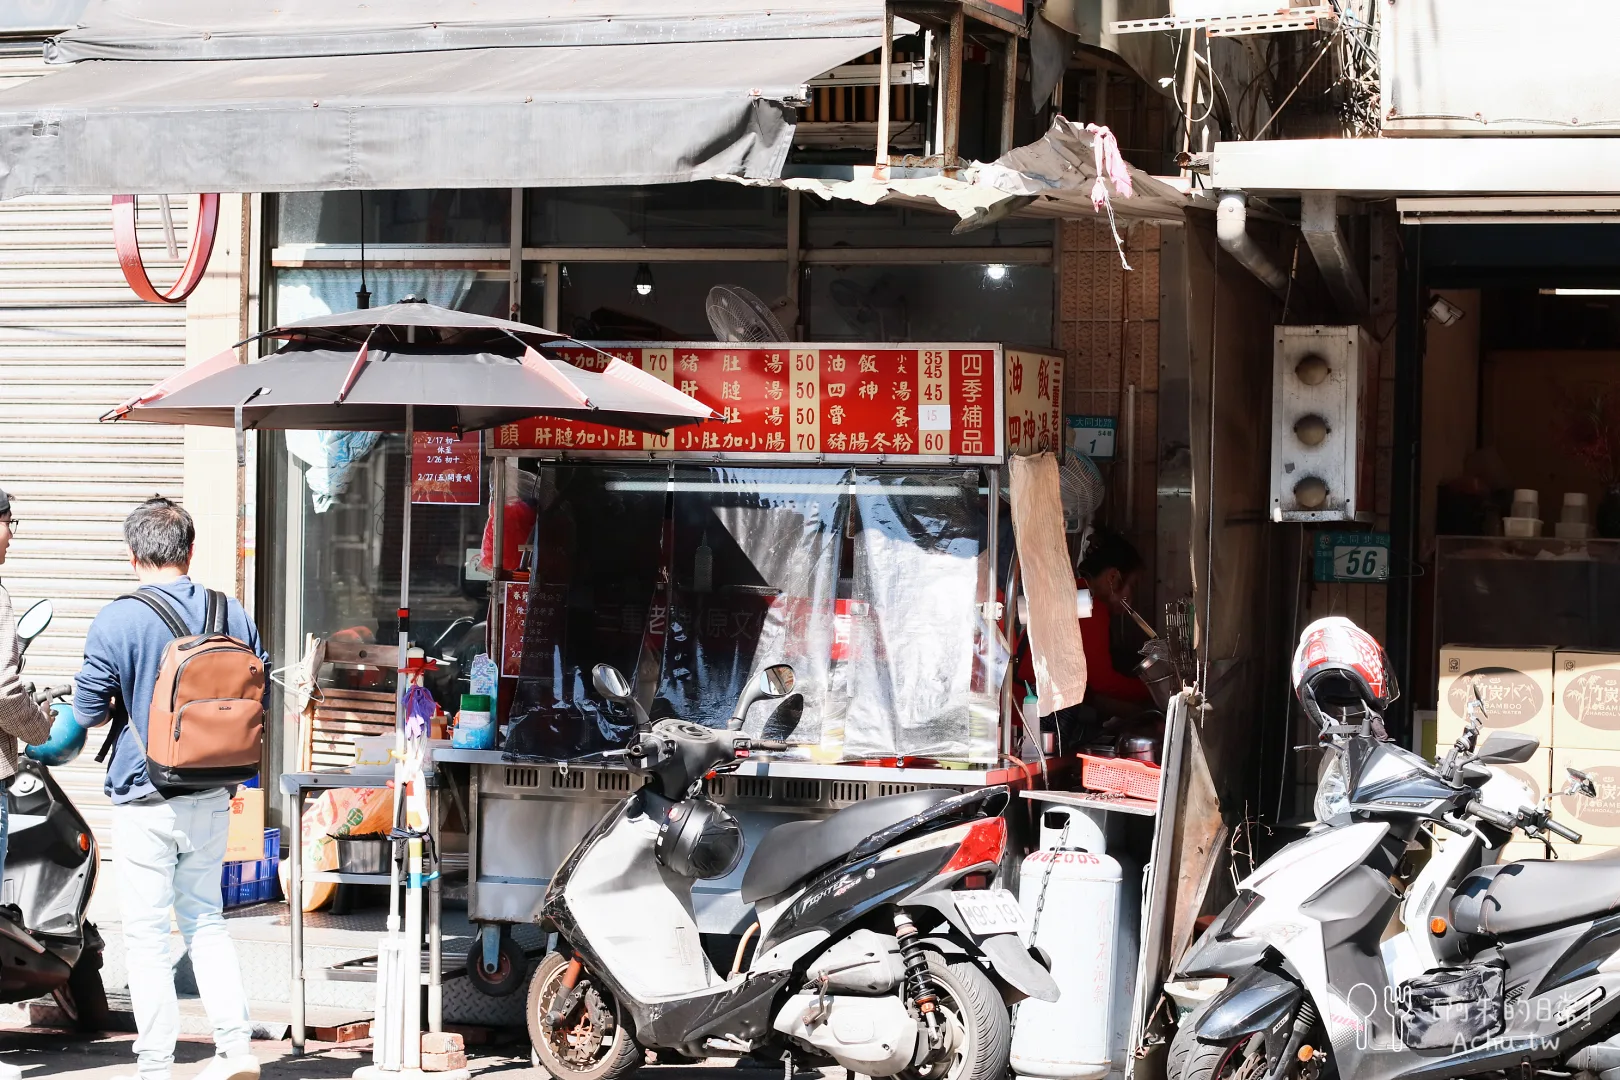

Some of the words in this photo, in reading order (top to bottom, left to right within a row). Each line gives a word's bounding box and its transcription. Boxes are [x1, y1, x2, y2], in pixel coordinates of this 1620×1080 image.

[650, 354, 667, 371] 70
[796, 354, 815, 371] 50
[827, 354, 879, 373] 油飯
[924, 351, 943, 365] 35
[923, 364, 943, 379] 45
[1008, 354, 1051, 401] 油飯
[796, 382, 815, 399] 50
[827, 380, 912, 401] 四神湯
[923, 384, 943, 401] 45
[961, 353, 983, 454] 四季補品
[796, 408, 815, 425] 50
[1075, 418, 1112, 428] 大同北路
[1008, 410, 1051, 453] 四神湯
[445, 436, 461, 445] 初一
[681, 431, 786, 452] 小肚加小腸
[796, 433, 815, 450] 70
[827, 432, 913, 452] 豬腸冬粉
[925, 433, 943, 451] 60
[1089, 439, 1097, 454] 1
[427, 455, 442, 464] 2/26
[444, 455, 460, 464] 初十
[1336, 534, 1386, 545] 大同北路
[1346, 550, 1378, 576] 56
[1485, 701, 1522, 710] BAMBOO
[801, 873, 853, 914] FIGHTER
